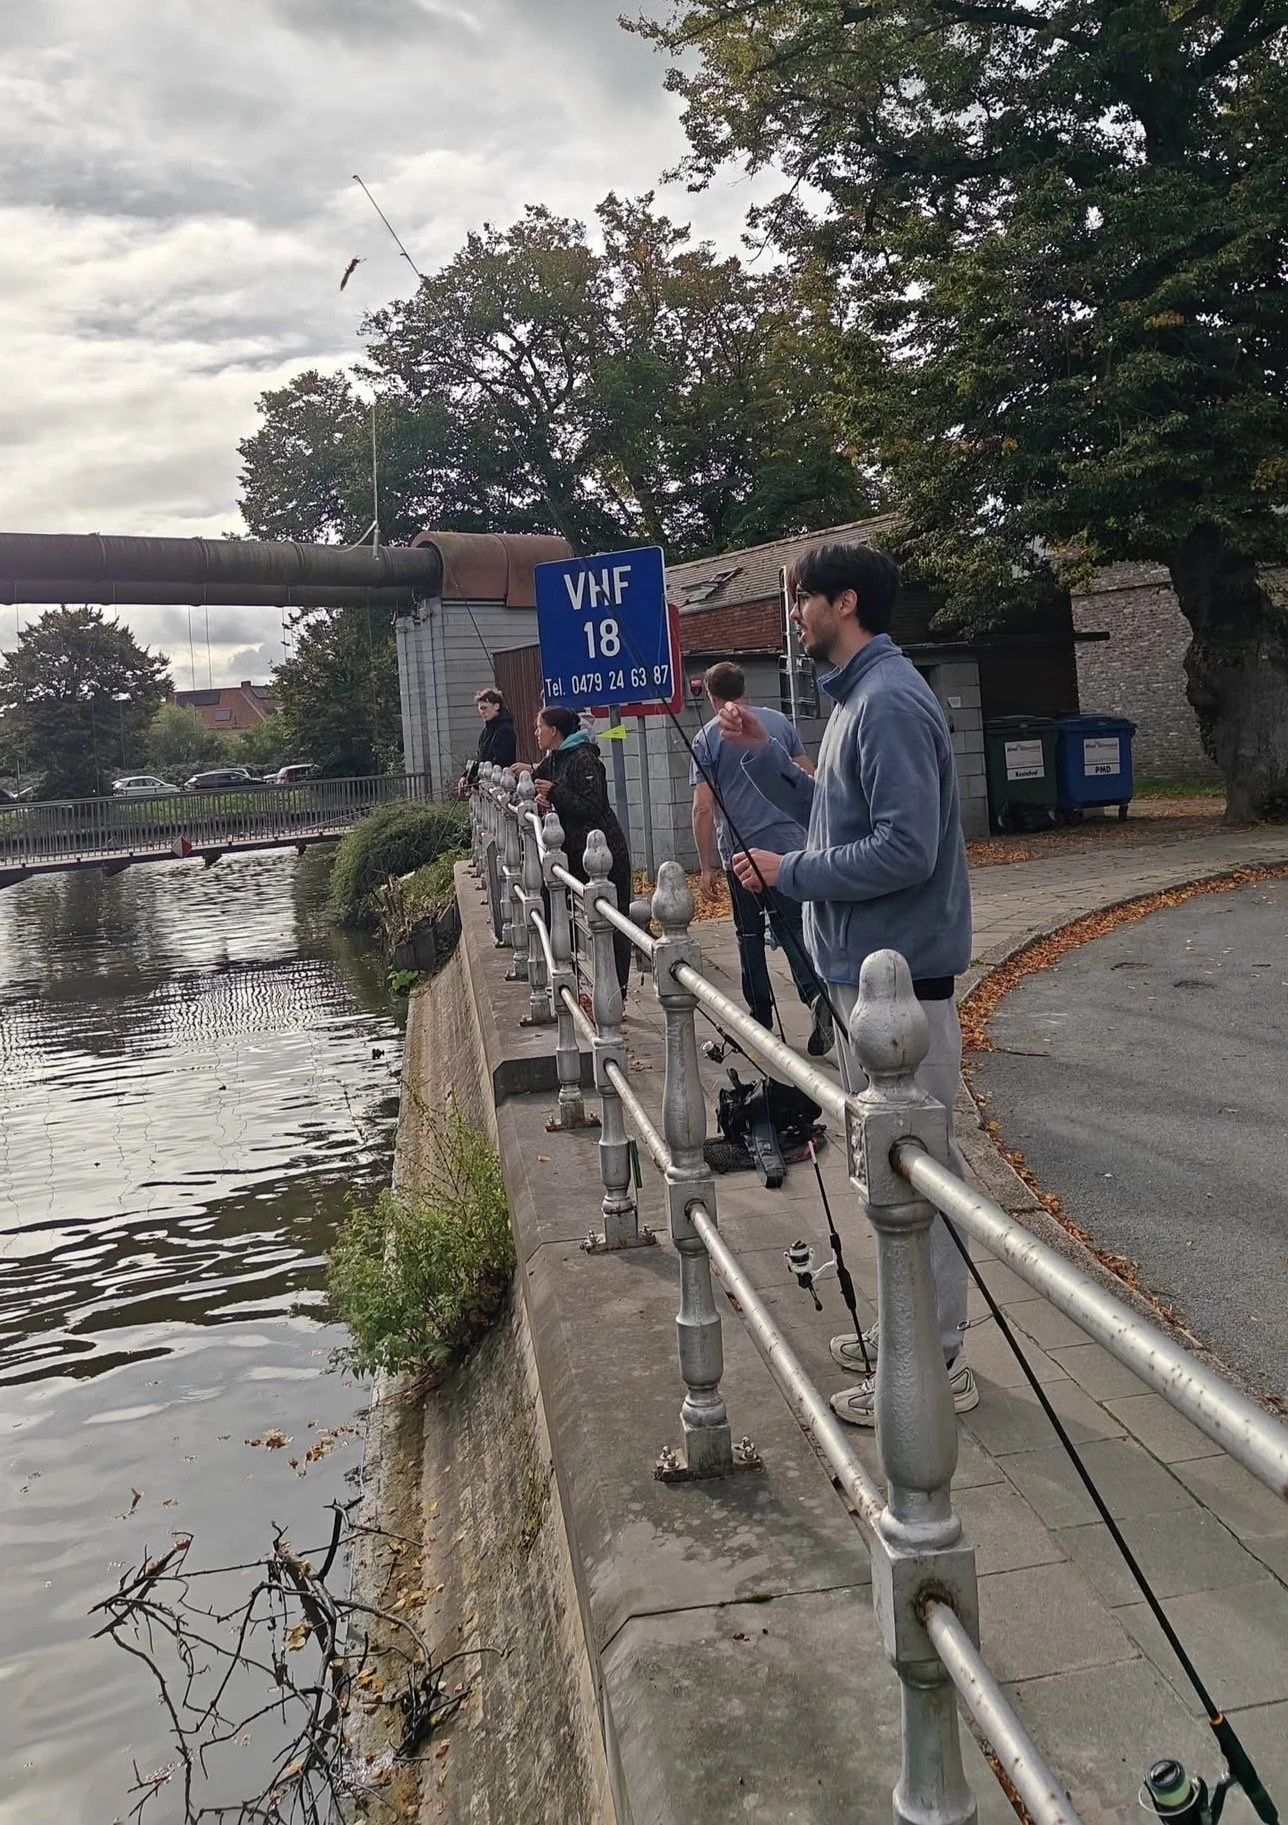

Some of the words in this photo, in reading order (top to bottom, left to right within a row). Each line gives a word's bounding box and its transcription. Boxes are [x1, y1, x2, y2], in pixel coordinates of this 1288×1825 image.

[563, 565, 632, 610] VHF
[583, 618, 621, 659] 18
[545, 678, 566, 697] Tel.
[571, 672, 603, 695] 0479
[609, 669, 625, 690] 24
[631, 667, 647, 688] 63
[653, 664, 669, 685] 87
[1095, 765, 1111, 774] PMD
